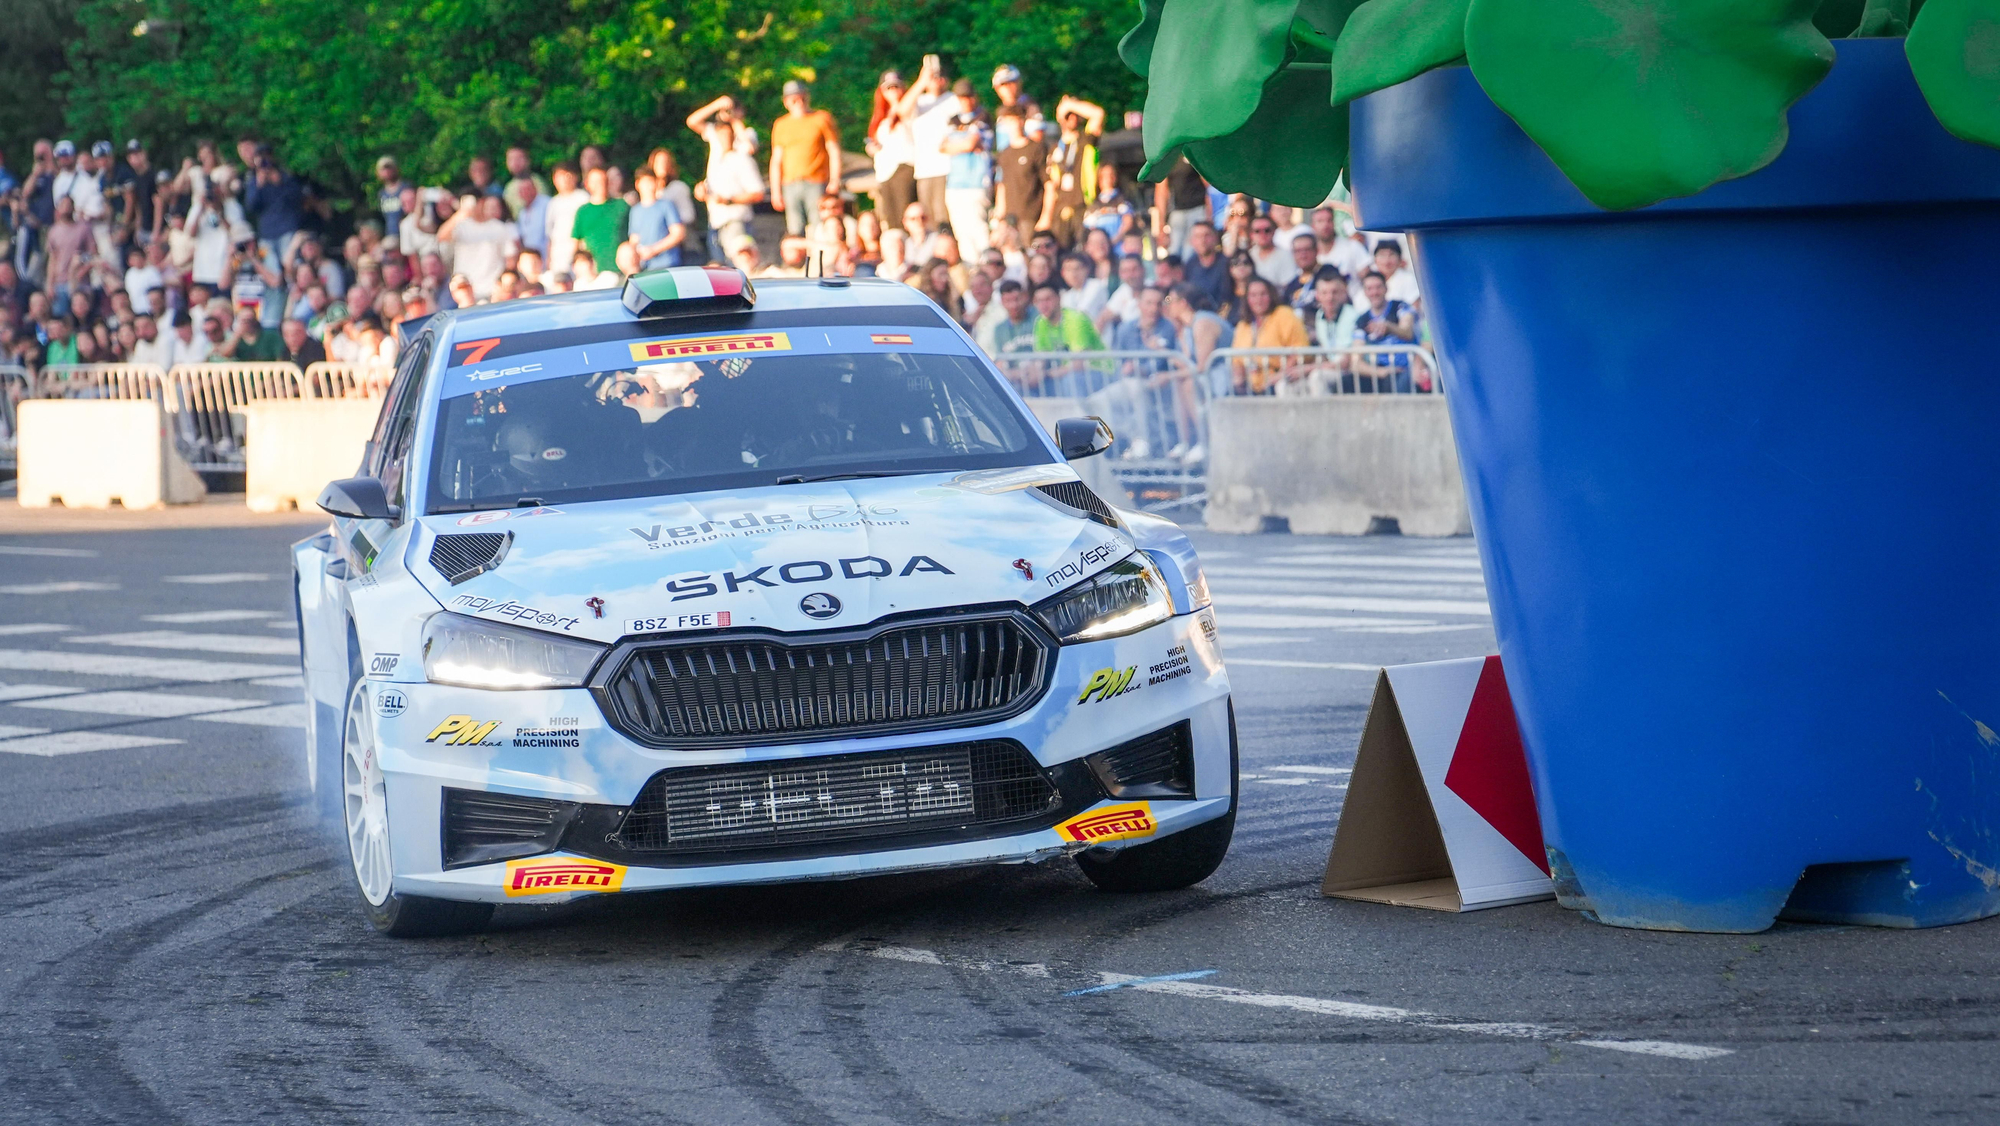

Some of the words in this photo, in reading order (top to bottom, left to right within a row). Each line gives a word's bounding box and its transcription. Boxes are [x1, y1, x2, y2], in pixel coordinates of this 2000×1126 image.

[455, 337, 501, 366] 7
[646, 336, 774, 357] PIRELLI
[479, 363, 543, 381] ERC
[628, 512, 793, 542] Verde
[743, 526, 776, 537] per
[1045, 535, 1127, 588] movisport
[451, 594, 580, 631] movisport
[633, 617, 668, 631] 8SZ
[678, 613, 712, 628] F5E
[1167, 645, 1186, 657] HIGH
[371, 656, 398, 672] OMP
[1149, 655, 1189, 675] PRECISION
[1077, 666, 1138, 705] PM
[1148, 665, 1192, 686] MACHINING
[425, 714, 502, 746] PM
[549, 717, 579, 726] HIGH
[516, 728, 579, 737] PRECISION
[512, 739, 580, 748] MACHINING
[1065, 809, 1151, 841] PIRELLI
[512, 865, 615, 891] PIRELLI
